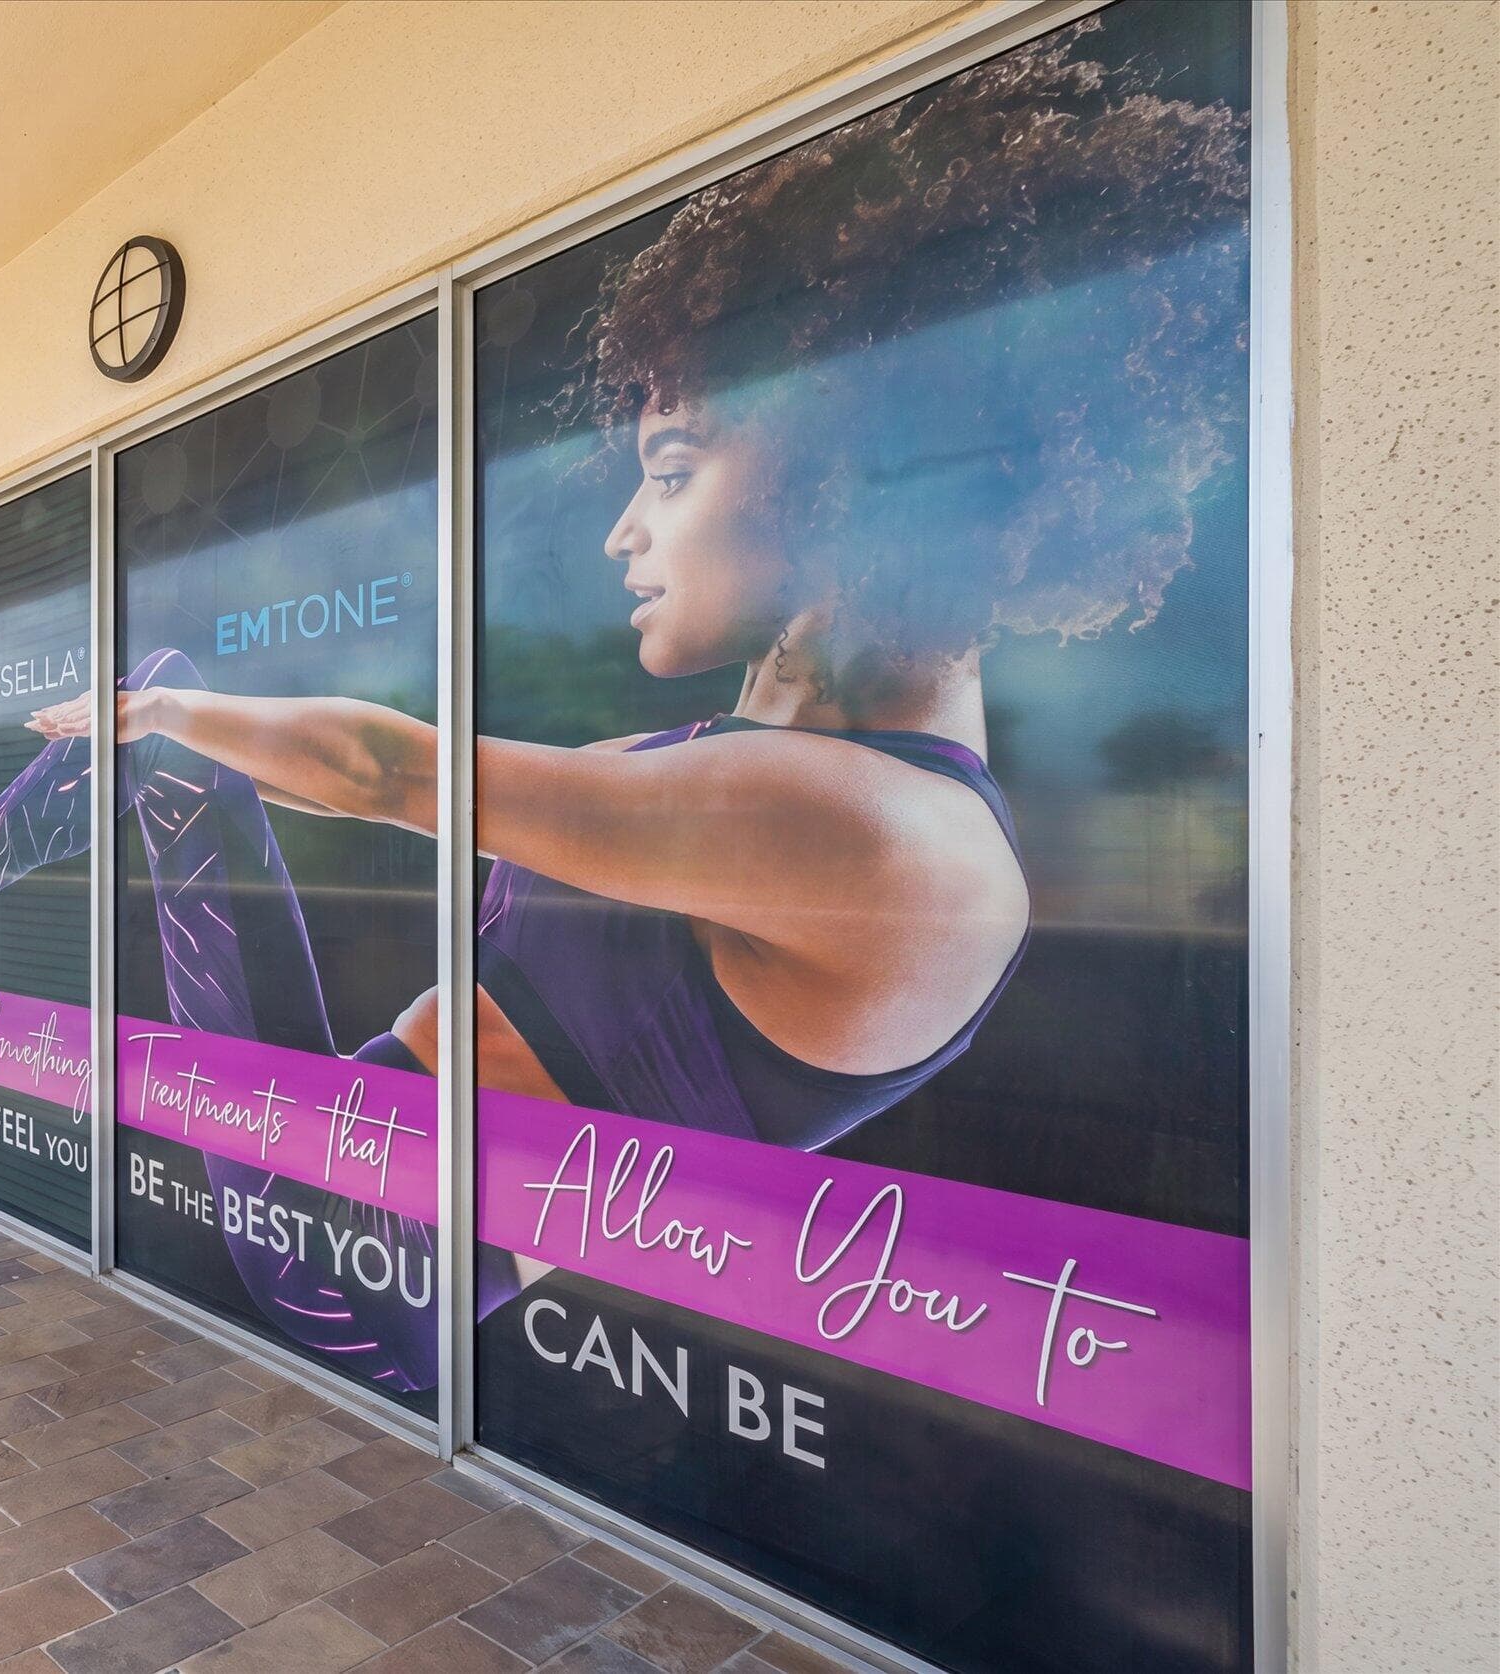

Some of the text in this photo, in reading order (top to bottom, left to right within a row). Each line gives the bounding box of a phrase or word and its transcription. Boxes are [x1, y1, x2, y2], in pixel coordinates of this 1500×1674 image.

[45, 1132, 88, 1173] YOU
[130, 1152, 165, 1206] BE
[171, 1180, 214, 1226] THE
[223, 1186, 314, 1262] BEST
[323, 1221, 431, 1309] YOU
[524, 1299, 688, 1419] CAN
[728, 1364, 825, 1470] BE
[316, 1077, 428, 1198] that
[523, 1123, 753, 1276] Allow
[795, 1177, 988, 1341] You
[1002, 1257, 1158, 1407] to
